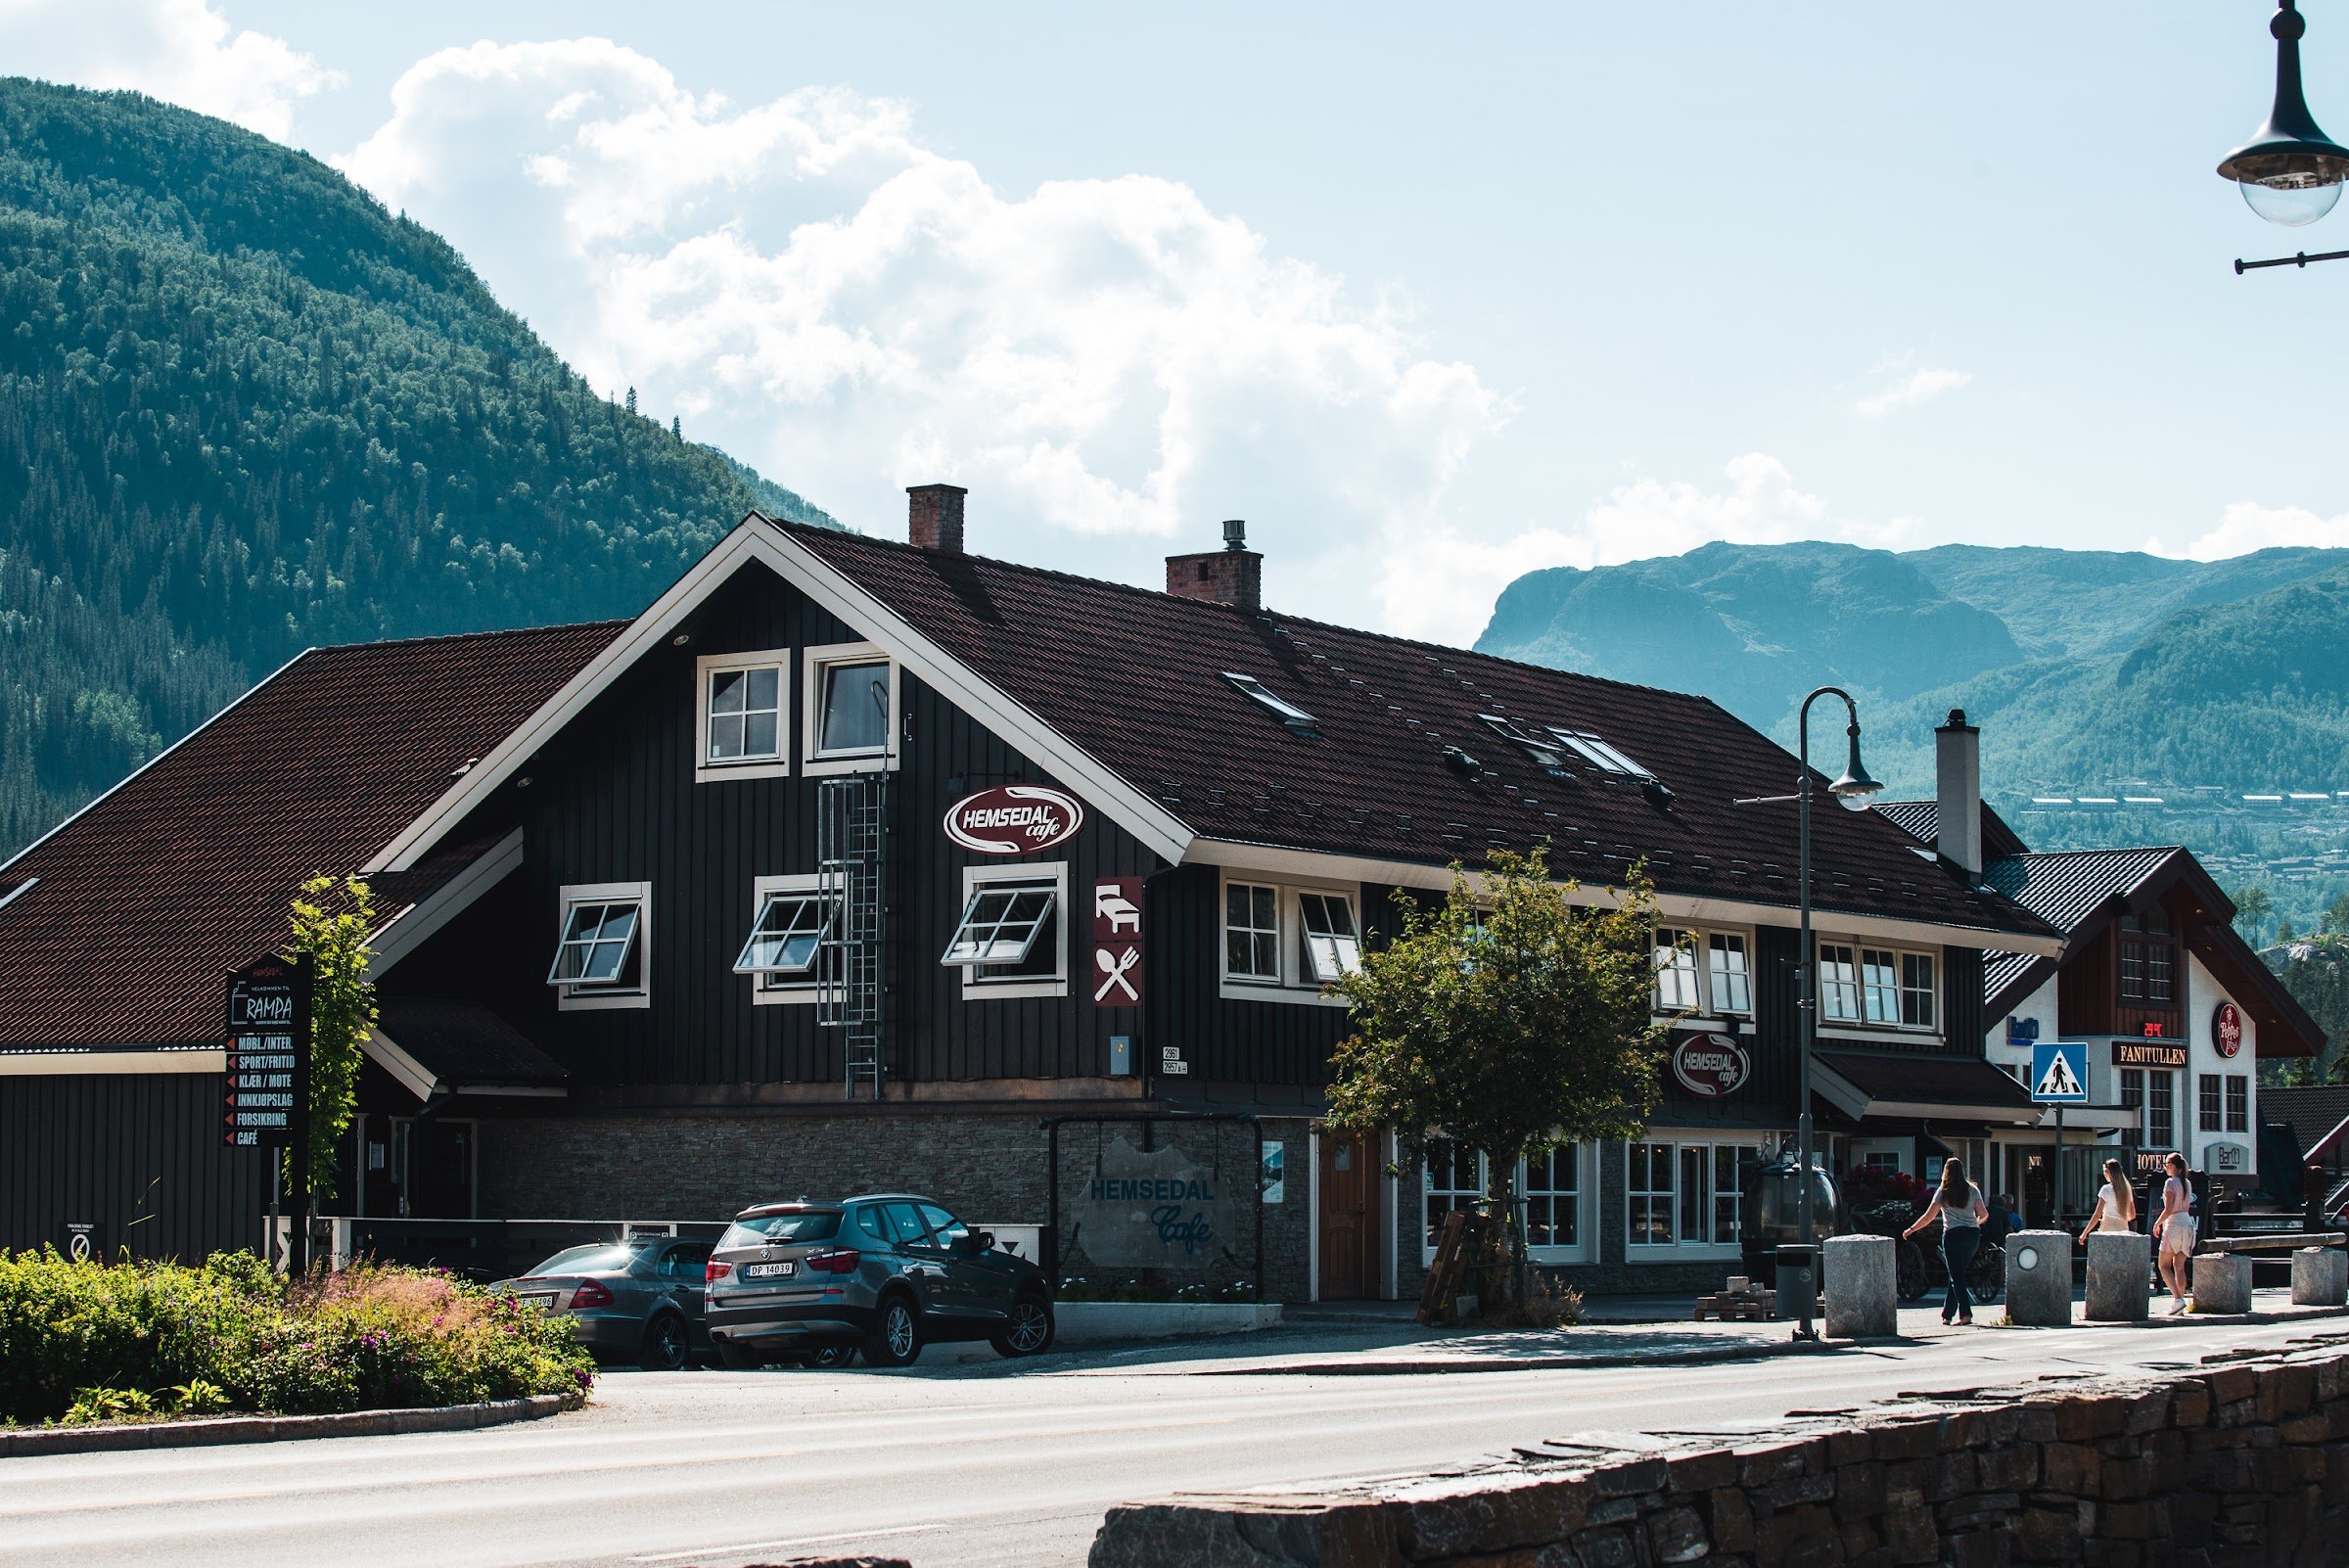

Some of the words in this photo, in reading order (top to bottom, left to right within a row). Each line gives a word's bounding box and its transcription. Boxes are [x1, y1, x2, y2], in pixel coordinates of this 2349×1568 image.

[962, 806, 1053, 829] HEMSEDAL
[1026, 817, 1061, 843] cafe
[247, 996, 292, 1020] RAMPA
[238, 1037, 294, 1051] MØBL./INTER.
[239, 1055, 296, 1070] SPORT/FRITID
[1683, 1052, 1732, 1071] HEMSEDAL
[2120, 1045, 2187, 1065] FANITULLEN
[239, 1074, 261, 1088] KLÆR
[269, 1074, 292, 1088] MOTE
[1719, 1065, 1738, 1087] cafe
[238, 1093, 294, 1107] INNKJØPSLAG
[237, 1113, 288, 1127] FORSIKRING
[237, 1130, 258, 1145] CAFÉ
[1090, 1179, 1215, 1200] HEMSEDAL
[1151, 1205, 1215, 1254] Cafe
[752, 1266, 762, 1275] DP
[765, 1265, 790, 1274] 14039
